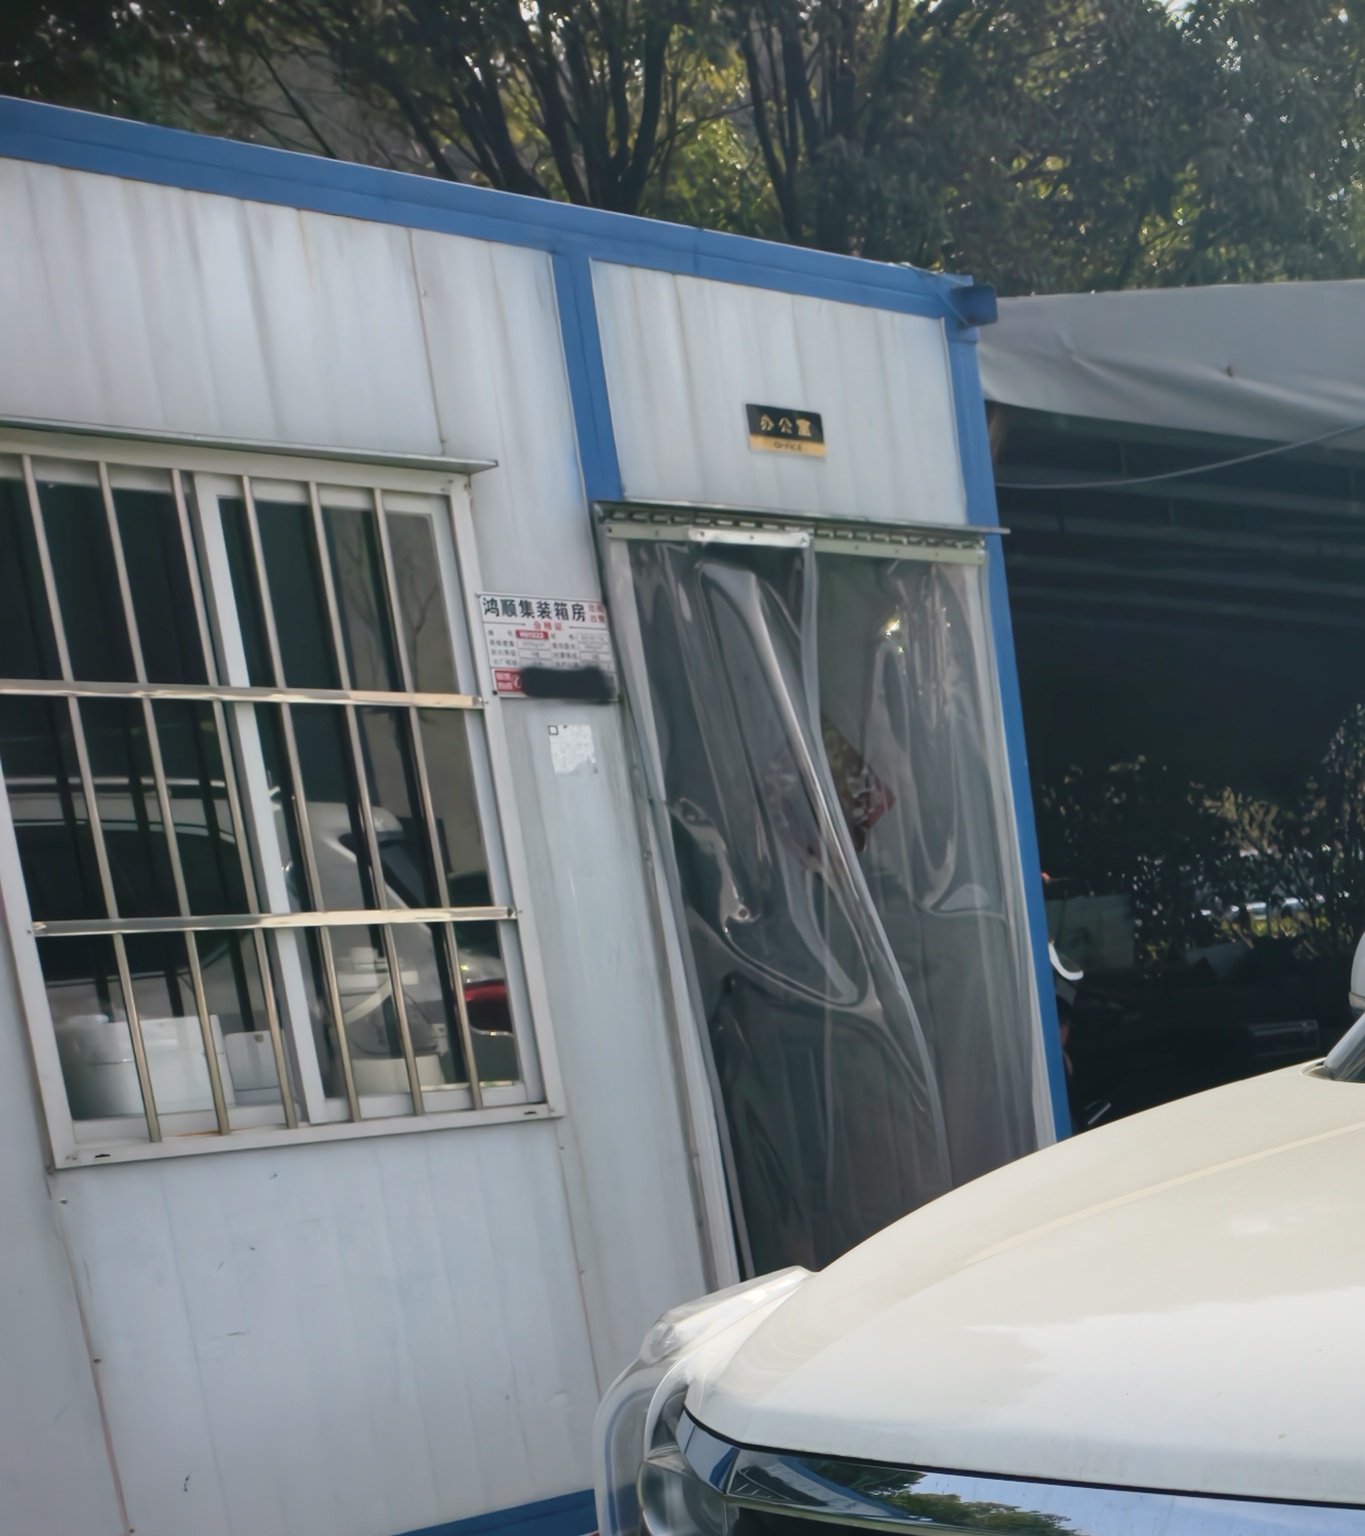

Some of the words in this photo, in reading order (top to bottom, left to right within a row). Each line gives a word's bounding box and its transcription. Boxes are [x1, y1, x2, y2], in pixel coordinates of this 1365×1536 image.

[759, 412, 812, 437] 办公室
[482, 596, 586, 623] 鸿顺集装箱房
